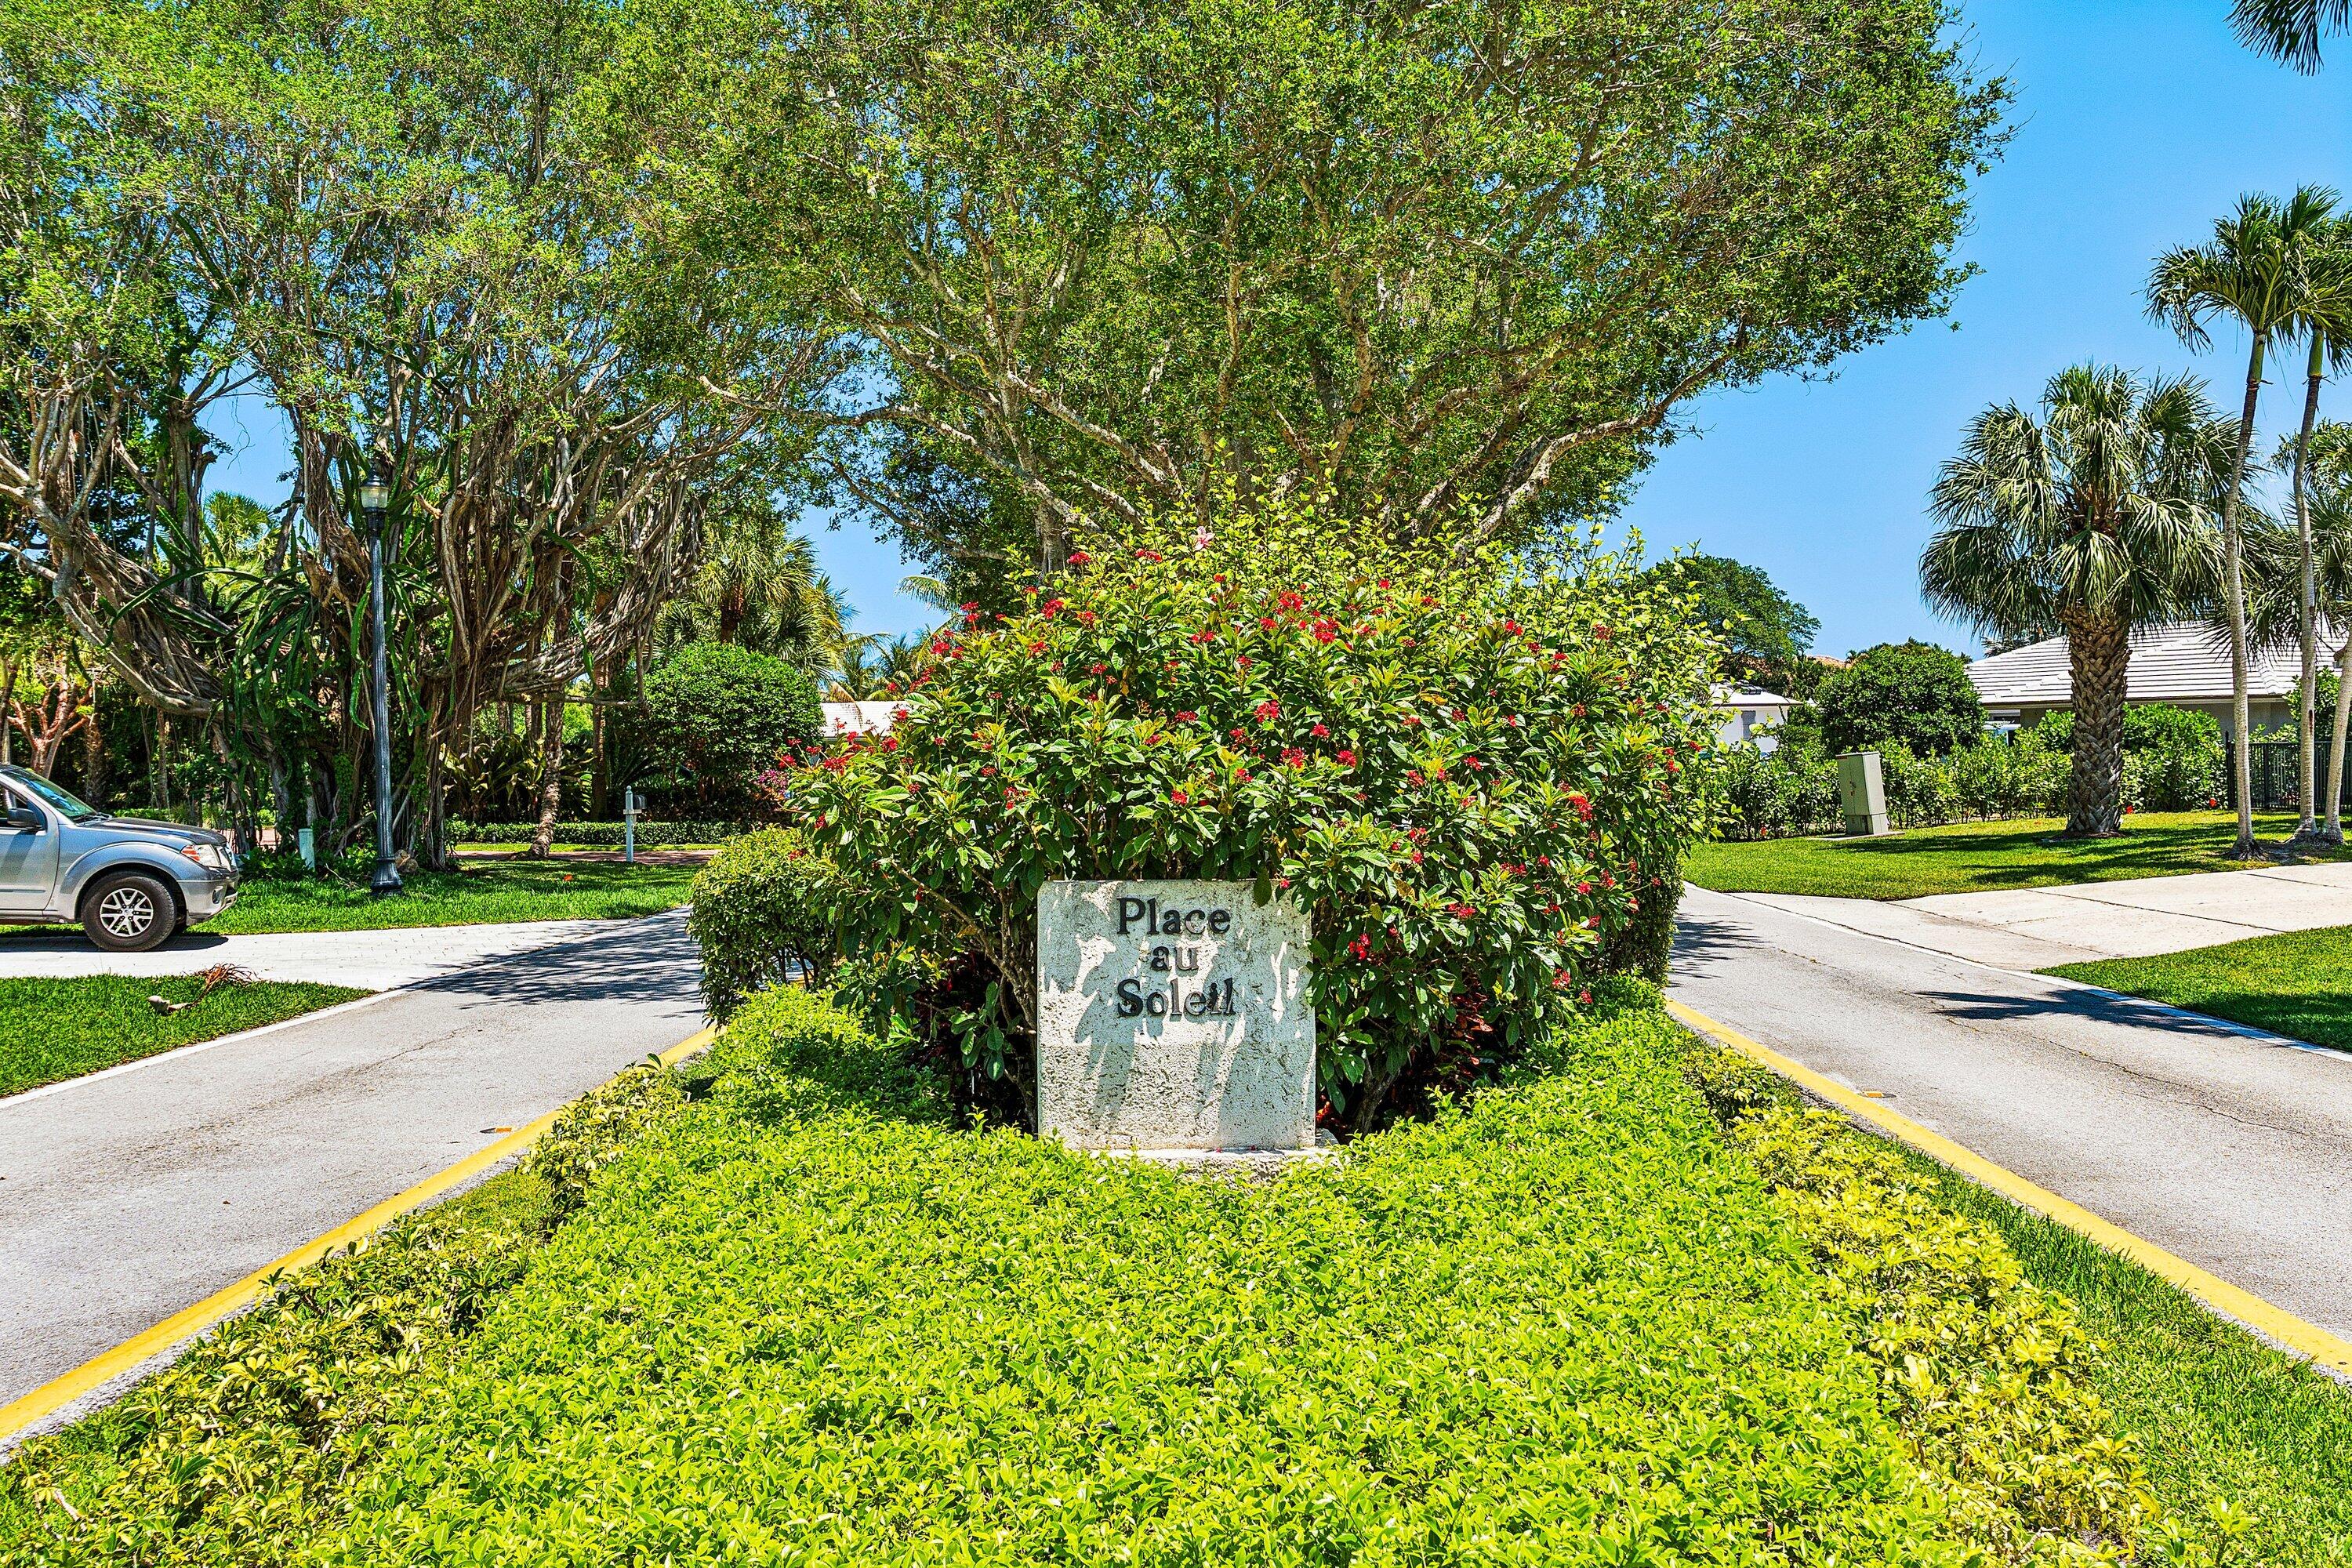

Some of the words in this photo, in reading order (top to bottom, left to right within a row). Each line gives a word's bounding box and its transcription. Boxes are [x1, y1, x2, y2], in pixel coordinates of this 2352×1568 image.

[1116, 897, 1231, 935] Place
[1151, 946, 1200, 971] au
[1117, 977, 1236, 1017] Soleil
